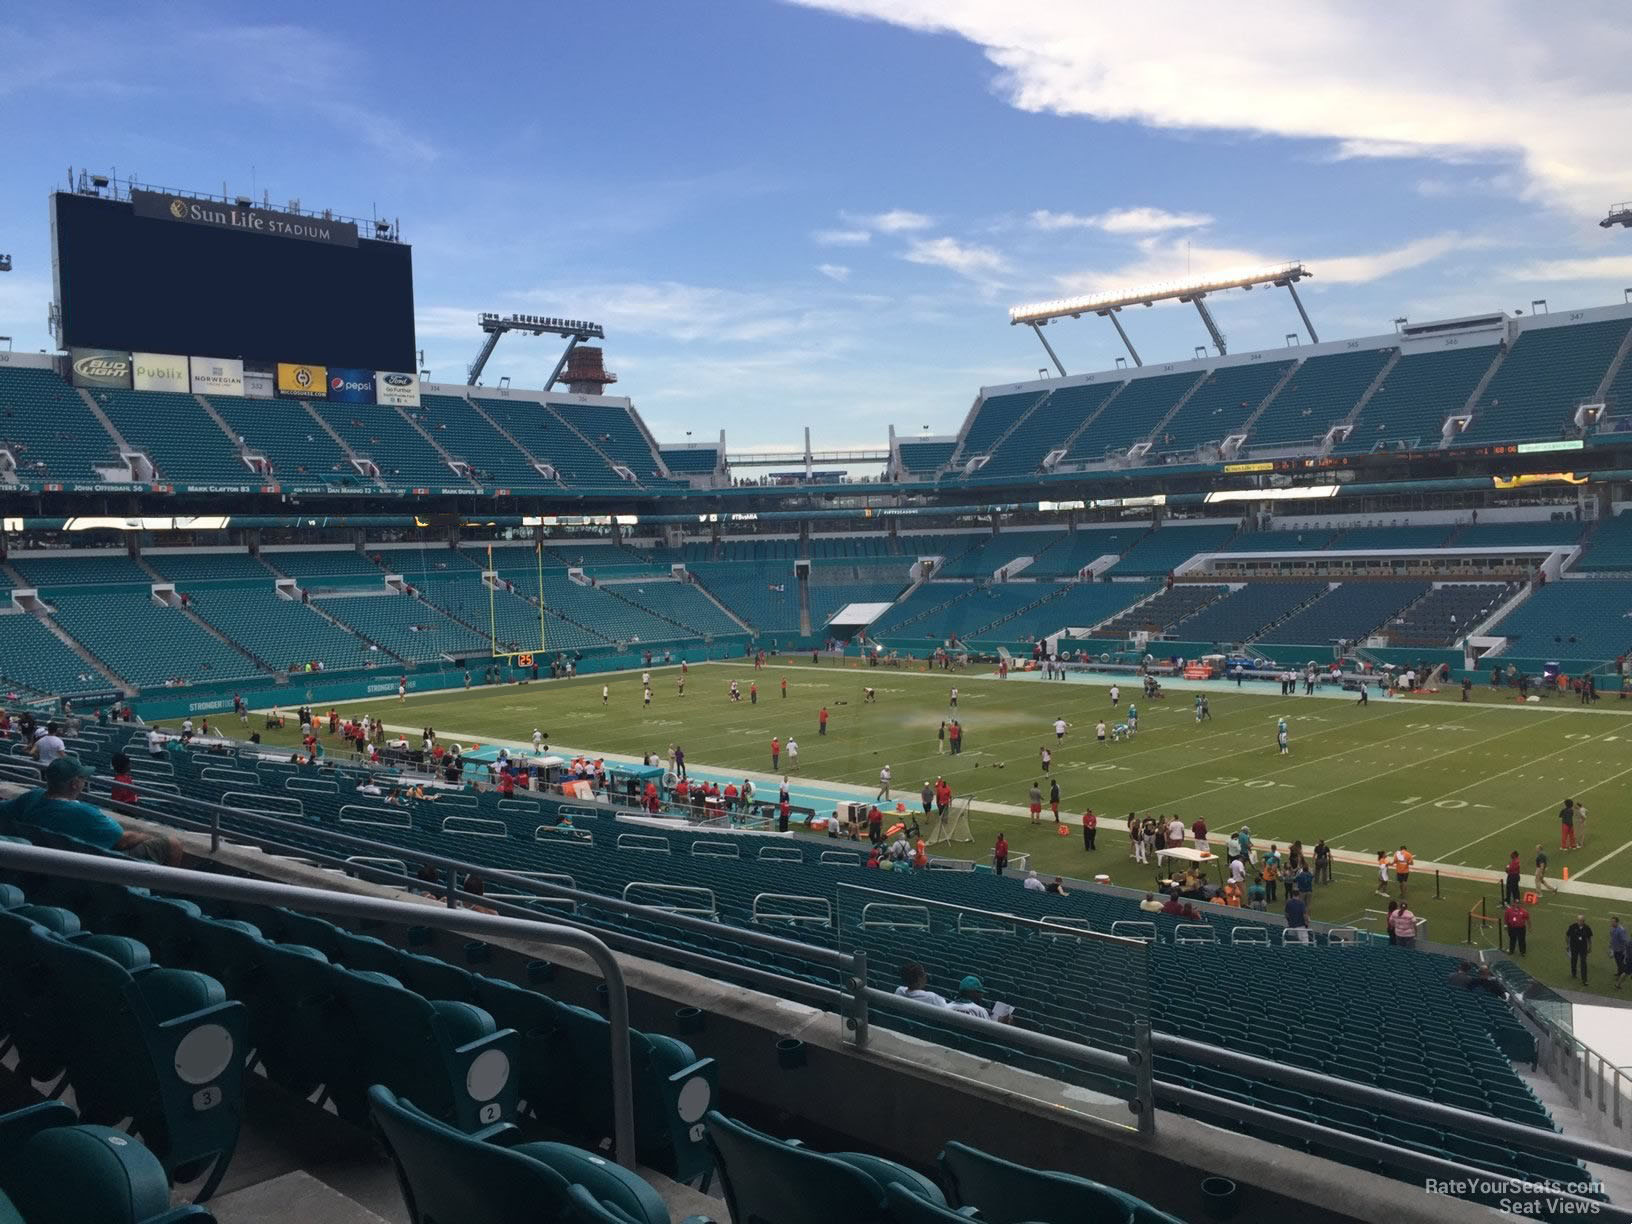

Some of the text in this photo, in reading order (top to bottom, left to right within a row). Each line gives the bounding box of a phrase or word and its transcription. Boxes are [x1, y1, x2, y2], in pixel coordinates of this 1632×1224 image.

[190, 204, 331, 240] Sun Life STADIUM
[89, 360, 127, 370] BUD
[83, 368, 129, 377] LIGHT
[194, 375, 242, 384] NORWEGIAN
[388, 375, 408, 385] Ford
[345, 382, 372, 393] pepsi
[520, 655, 532, 665] 25
[202, 1093, 212, 1105] 3
[487, 1107, 494, 1120] 2
